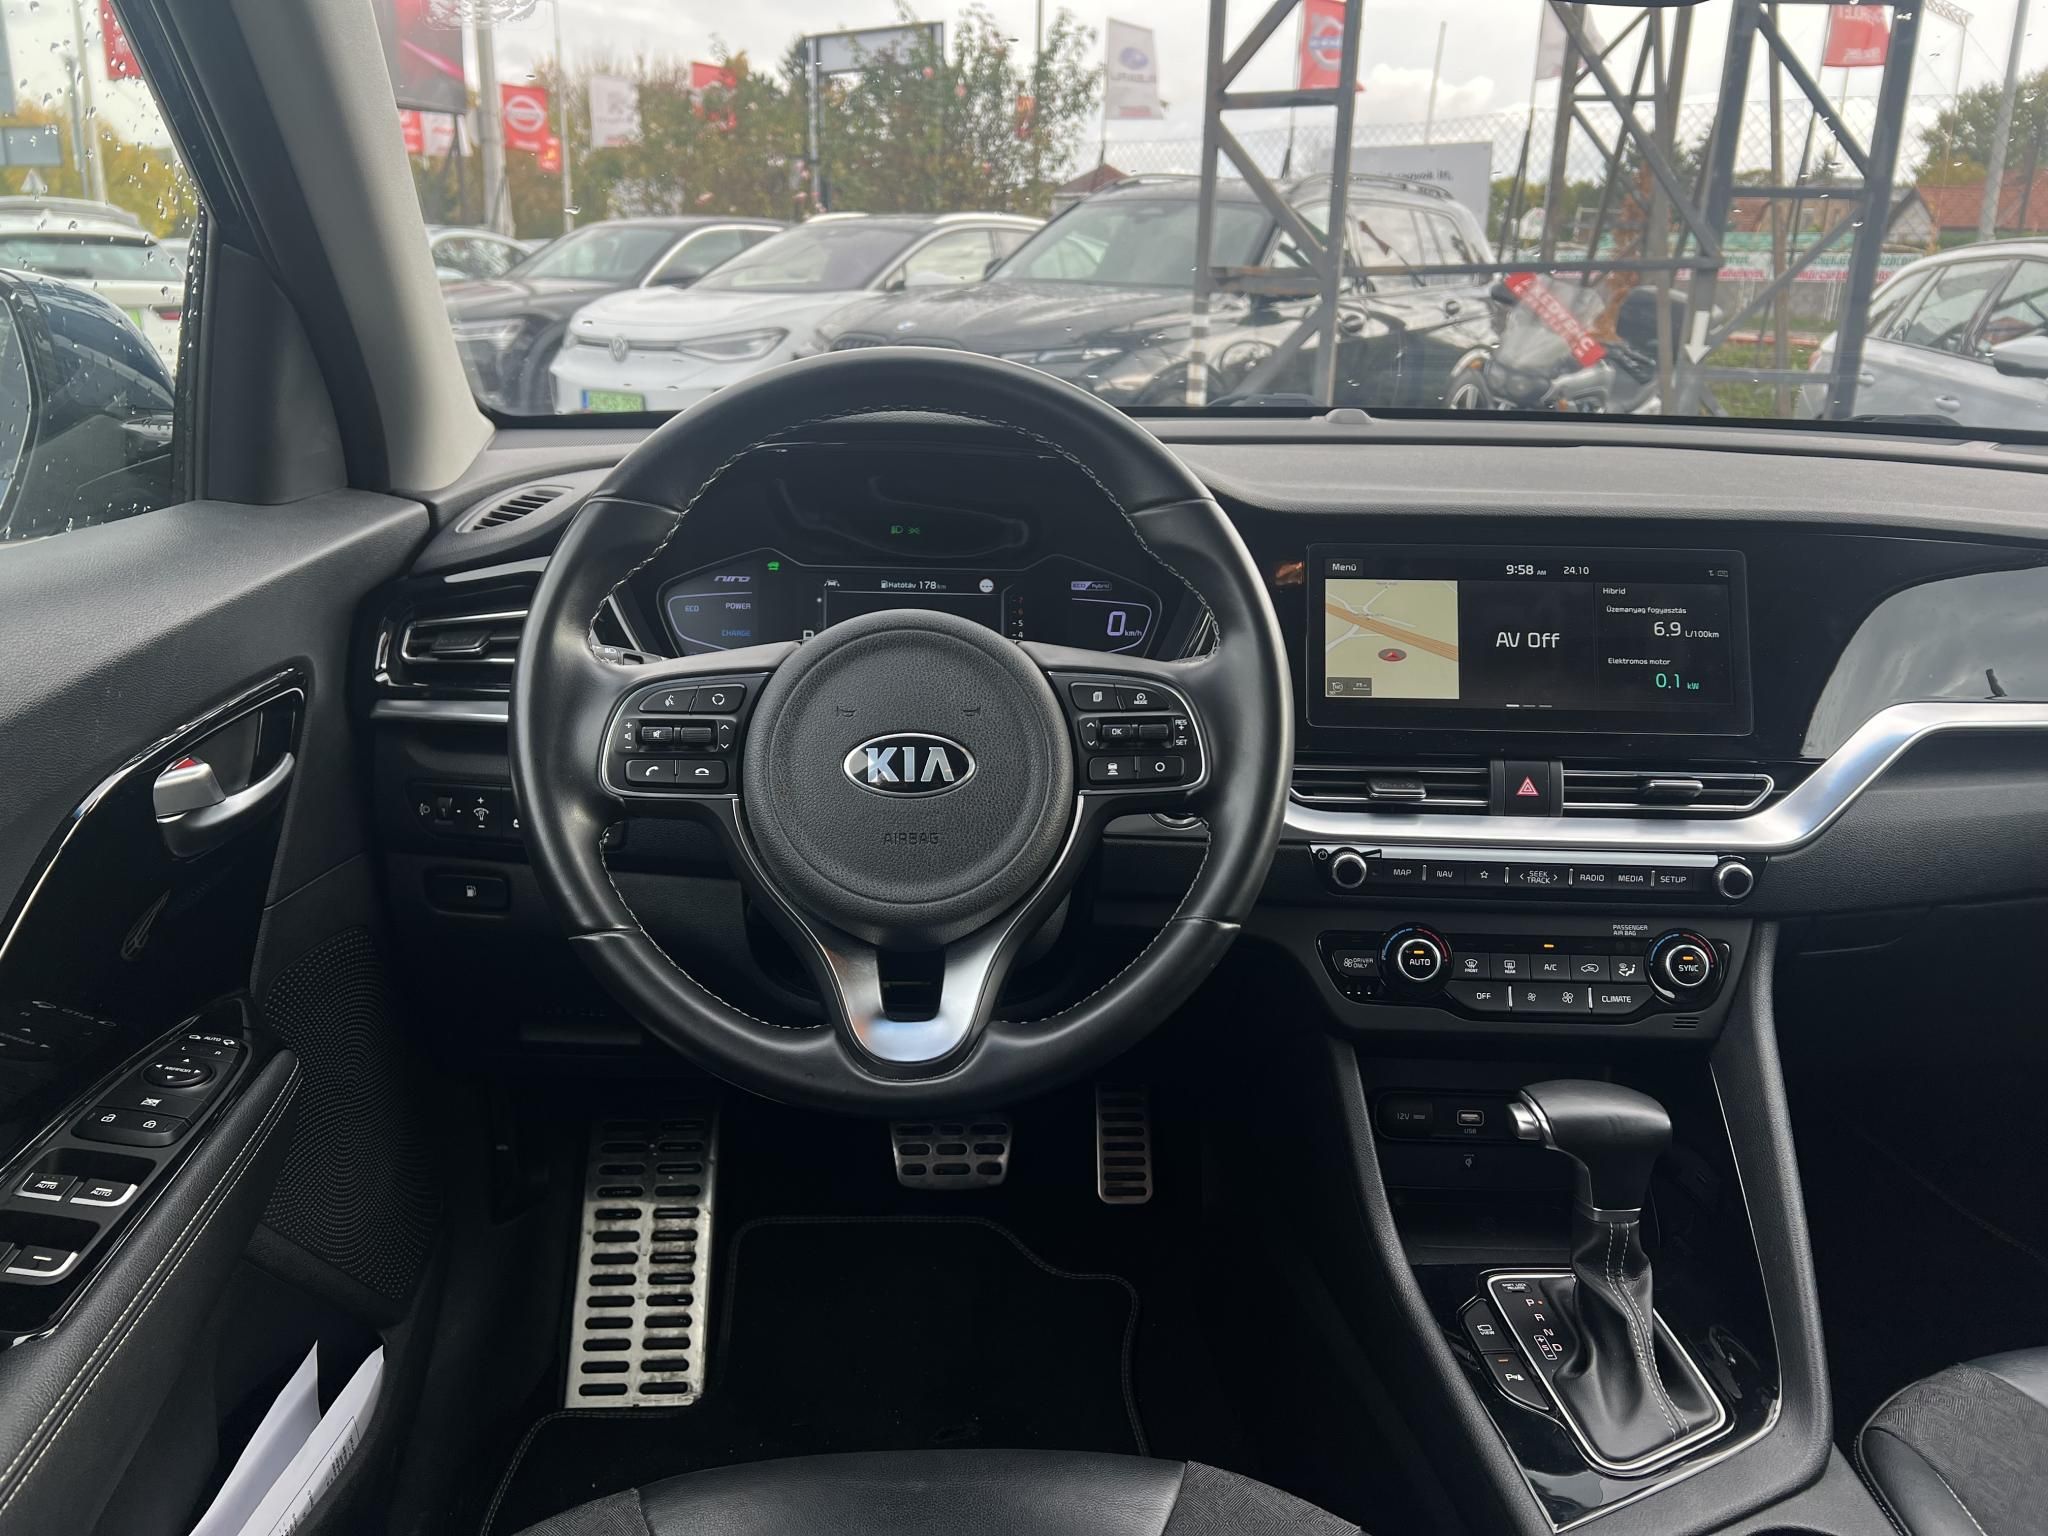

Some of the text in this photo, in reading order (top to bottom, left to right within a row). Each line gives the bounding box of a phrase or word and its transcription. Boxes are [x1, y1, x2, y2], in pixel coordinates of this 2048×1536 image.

[1332, 563, 1357, 572] Menü
[1505, 564, 1534, 575] 9:58
[1563, 566, 1590, 575] 24.10
[919, 580, 937, 590] 178
[1602, 587, 1626, 595] Hibrid
[684, 604, 700, 613] ECO
[725, 602, 751, 610] POWER
[1606, 604, 1687, 615] Üzemanyag fogyasztás
[1107, 611, 1143, 637] 0 km/h
[721, 629, 751, 637] CHARGE
[1653, 621, 1720, 639] 6.9 L/100km
[1495, 631, 1560, 648] AV Off
[1607, 657, 1648, 666] Elektromos
[1655, 673, 1700, 690] 0.1 kW
[866, 746, 955, 783] KIA
[883, 832, 940, 846] AIRBAG
[1393, 868, 1412, 876] MAP
[1436, 870, 1453, 878] NAV
[1580, 873, 1605, 882] RADIO
[1618, 875, 1644, 883] MEDIA
[1660, 876, 1687, 884] SETUP
[1409, 958, 1431, 967] AUTO
[1544, 963, 1557, 972] A/C
[1678, 964, 1700, 973] SYNC
[1476, 992, 1492, 1000] OFF
[1601, 994, 1632, 1004] CLIMATE
[35, 1182, 56, 1190] AUTO
[90, 1189, 112, 1198] AUTO
